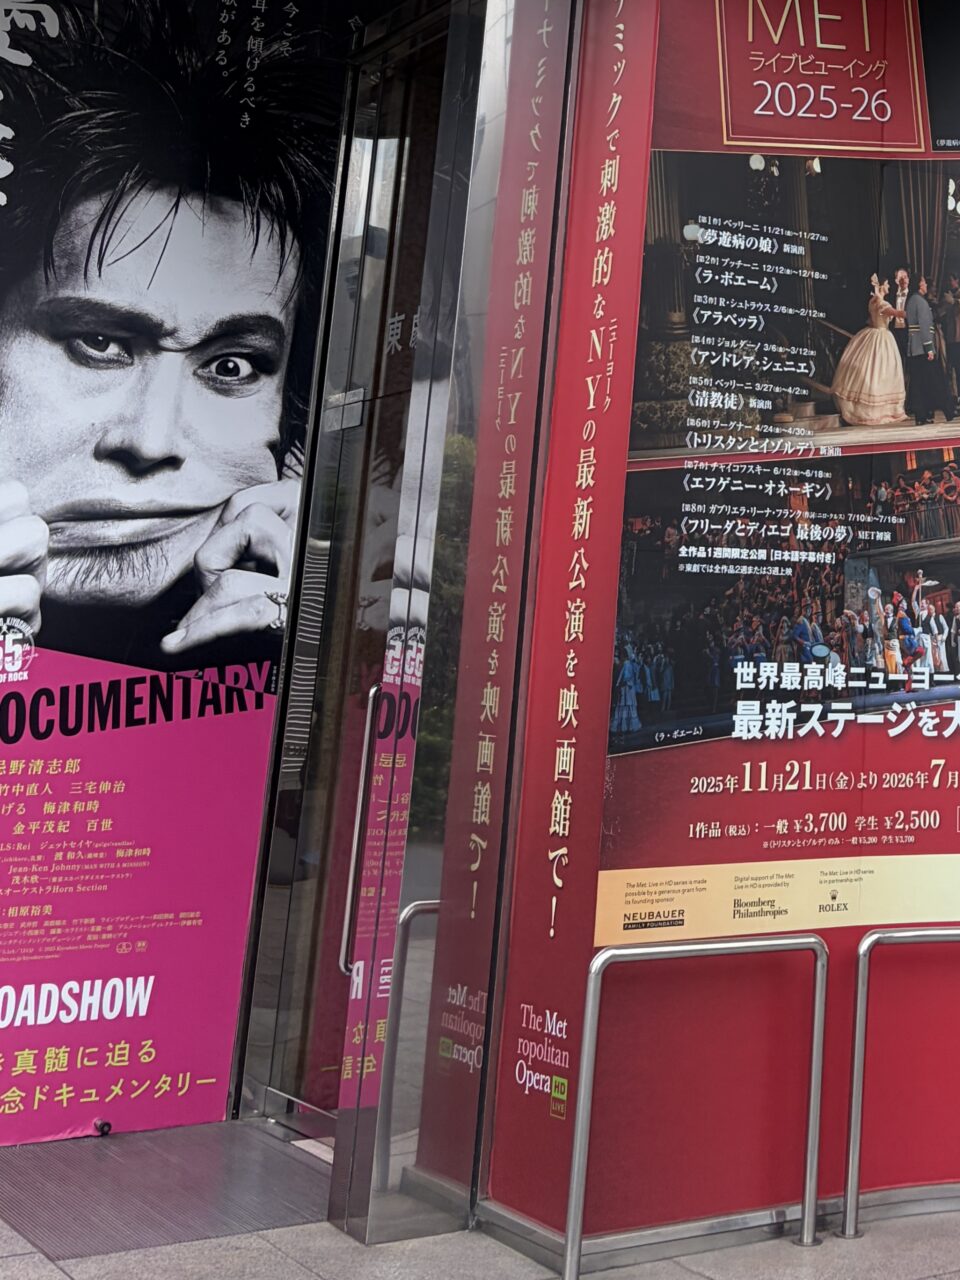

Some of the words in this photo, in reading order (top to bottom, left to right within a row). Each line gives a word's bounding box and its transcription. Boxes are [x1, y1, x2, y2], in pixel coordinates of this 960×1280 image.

[749, 51, 888, 80] ライブビューイング
[753, 80, 892, 122] 2025-26
[623, 909, 685, 921] NEUBAUER
[733, 897, 775, 909] Bloomberg
[733, 906, 788, 919] Philanthropies
[818, 903, 848, 912] ROLEX
[520, 1004, 543, 1031] The
[544, 1010, 567, 1039] Met
[0, 1039, 157, 1076] 真髄に迫る
[517, 1037, 569, 1068] ropolitan
[515, 1060, 551, 1094] Opera
